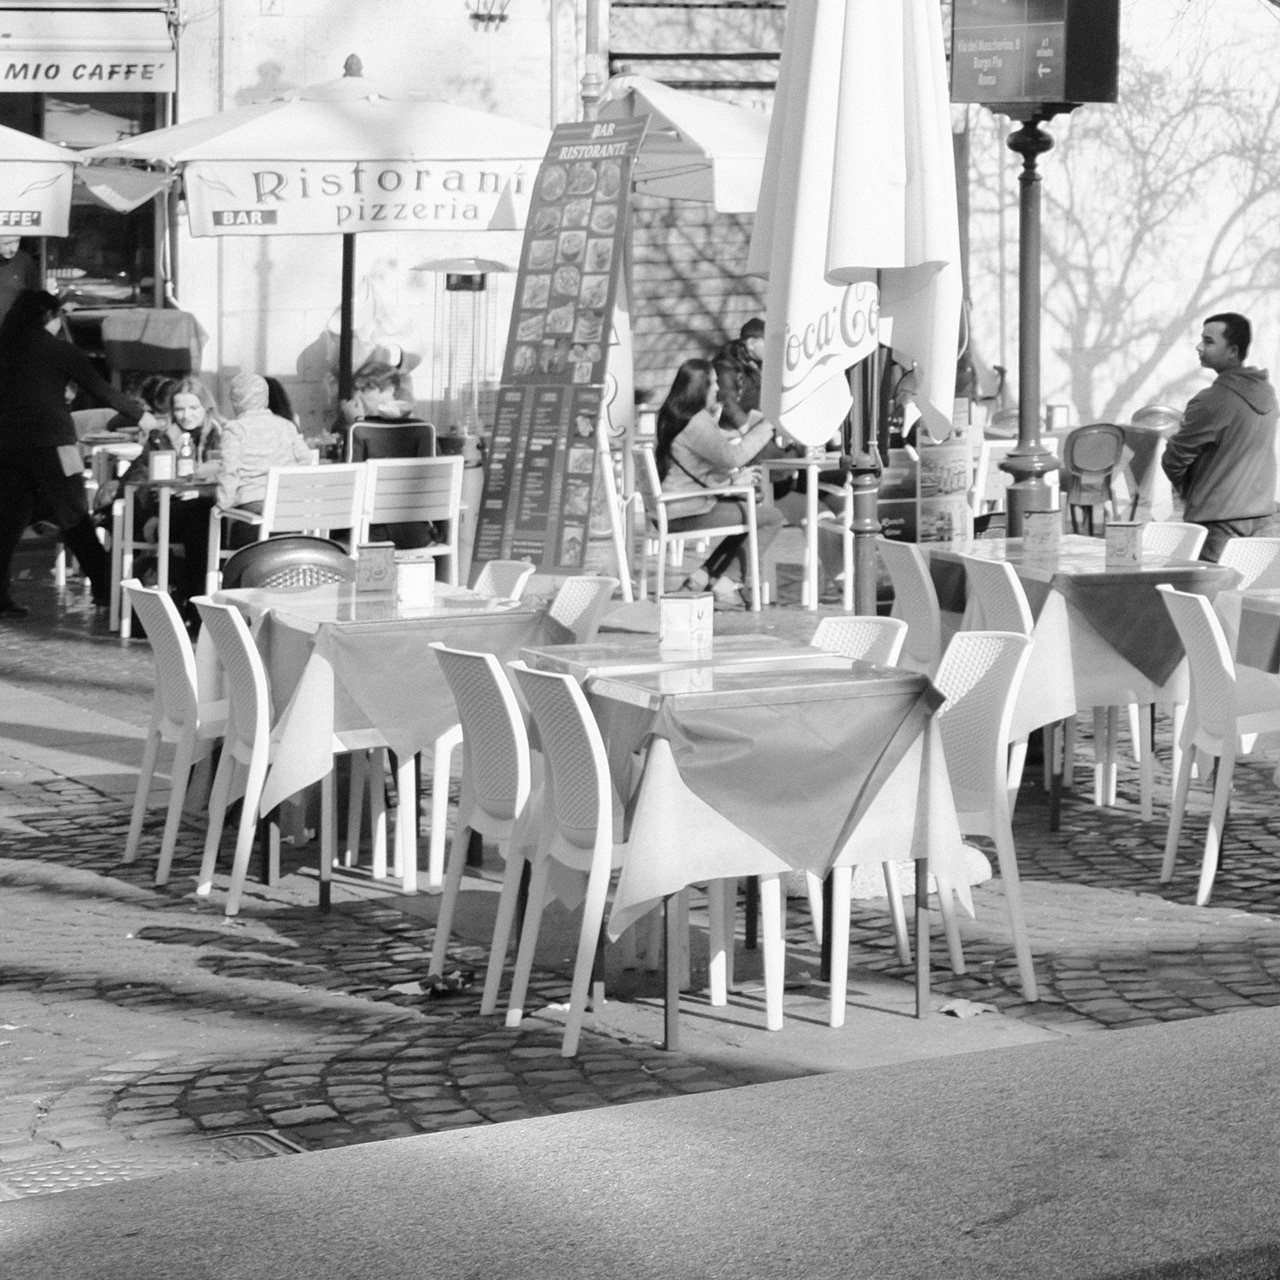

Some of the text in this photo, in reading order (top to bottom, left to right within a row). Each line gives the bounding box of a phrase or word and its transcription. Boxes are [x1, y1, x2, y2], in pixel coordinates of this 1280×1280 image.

[4, 63, 165, 80] MIO CAFFE'
[591, 123, 616, 139] BAR
[559, 143, 628, 160] RISTORANTE
[222, 211, 263, 226] BAR
[336, 198, 480, 226] pizzeria
